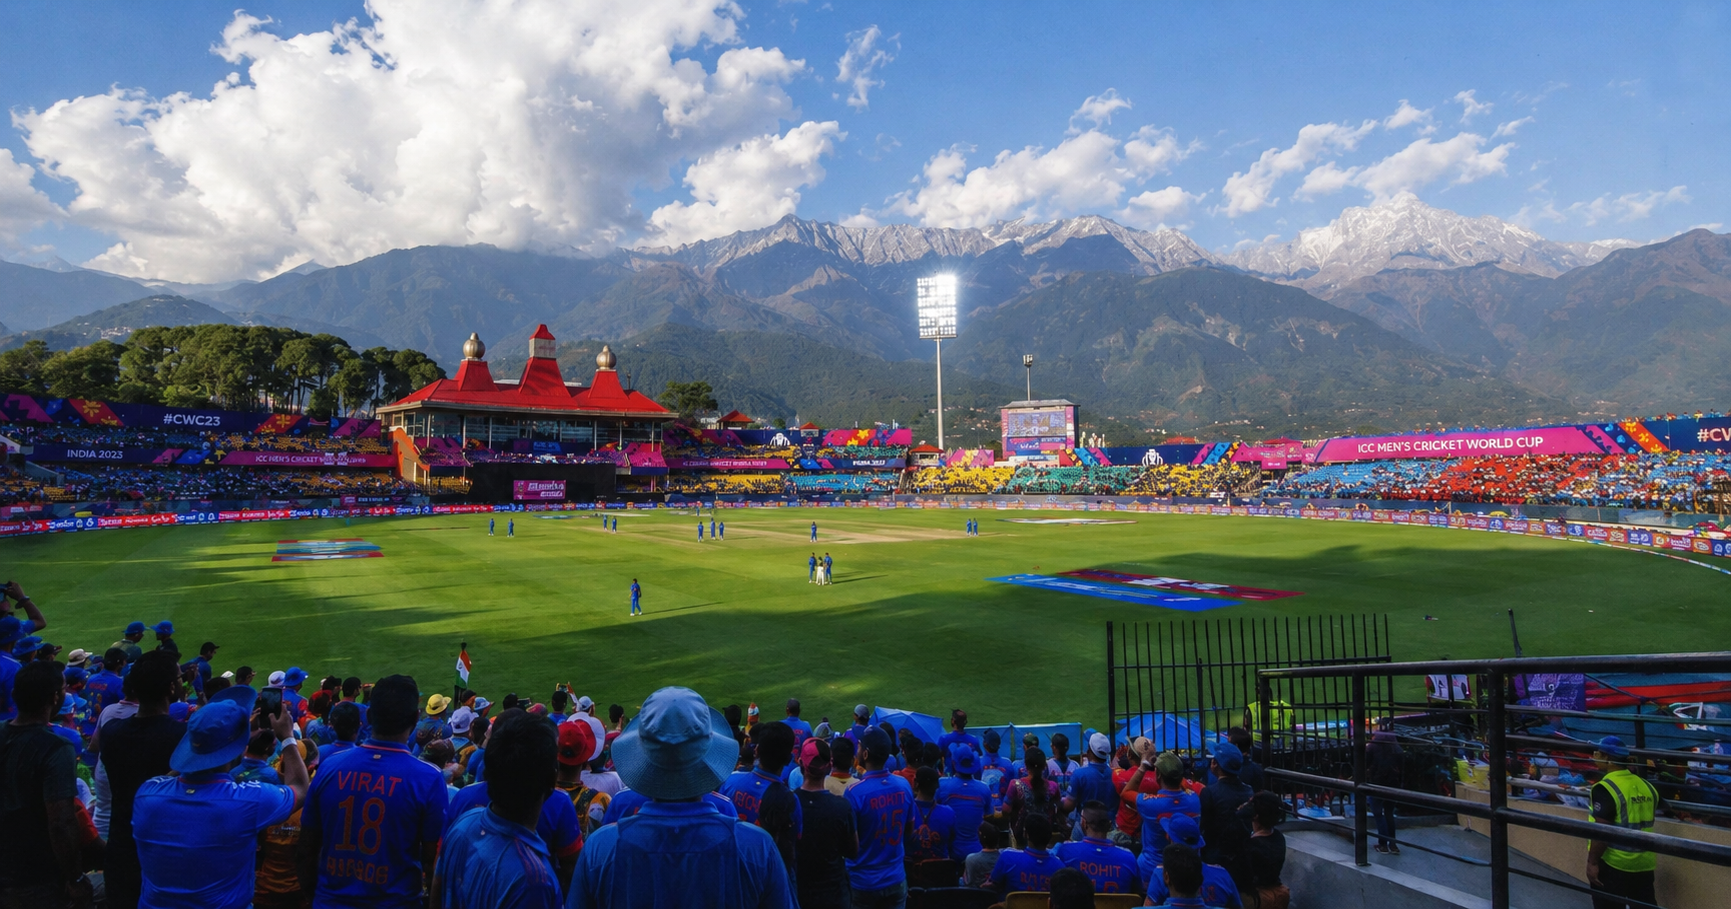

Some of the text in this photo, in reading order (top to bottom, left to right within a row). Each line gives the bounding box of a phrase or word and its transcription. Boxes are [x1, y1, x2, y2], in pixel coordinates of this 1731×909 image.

[163, 413, 221, 427] #CWC23
[1357, 436, 1544, 453] ICC MEN'S CRICKET WORLD CUP
[67, 449, 123, 459] INDIA 2023
[338, 770, 402, 797] VIRAT
[335, 795, 386, 855] 18
[1079, 861, 1121, 878] ROHIT
